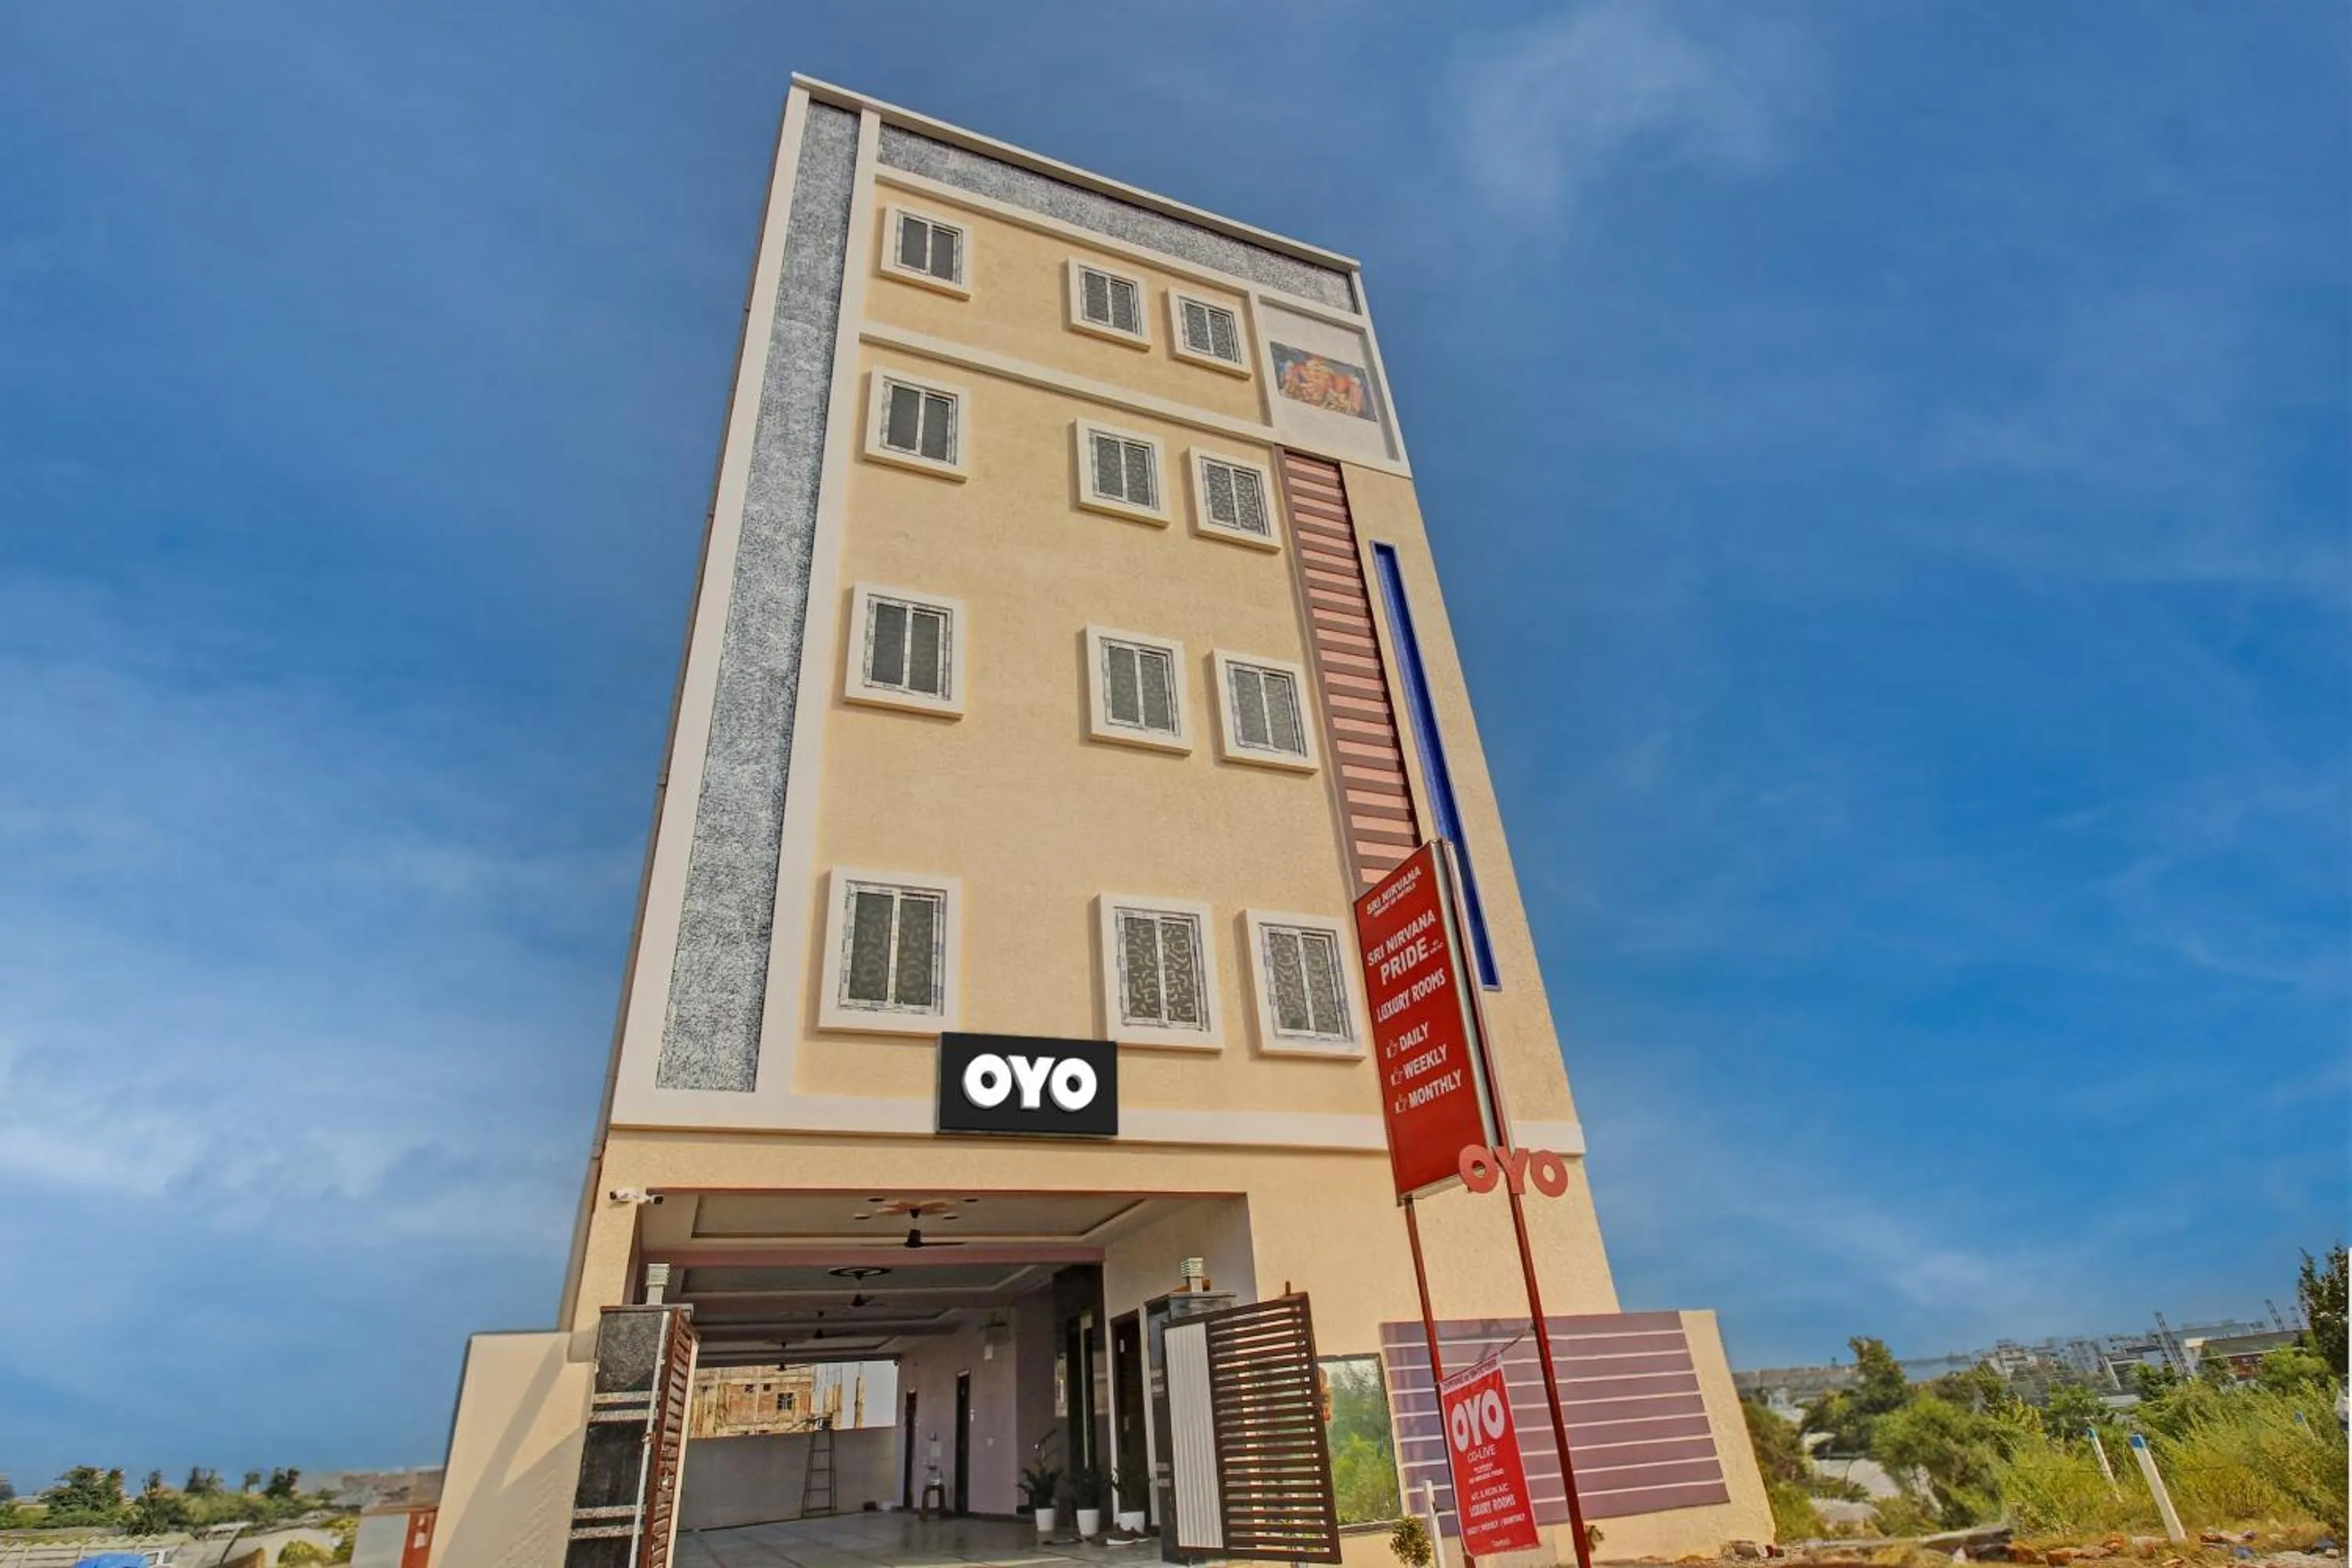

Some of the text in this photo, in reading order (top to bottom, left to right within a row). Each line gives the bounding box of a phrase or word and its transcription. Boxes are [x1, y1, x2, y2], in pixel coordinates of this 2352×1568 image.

[1367, 897, 1382, 915] SRI
[1381, 866, 1422, 904] NIRVANA
[1367, 944, 1385, 967] SRI
[1386, 909, 1436, 954] NIRVANA
[1380, 936, 1429, 985] PRIDE
[1376, 967, 1446, 1022] LUXURY ROOMS
[1399, 1022, 1429, 1052] DAILY
[1403, 1044, 1447, 1080] WEEKLY
[962, 1053, 1098, 1112] OYO
[1408, 1069, 1462, 1109] MONTHLY
[1458, 1144, 1569, 1198] OYO
[1452, 1388, 1505, 1453] OYO
